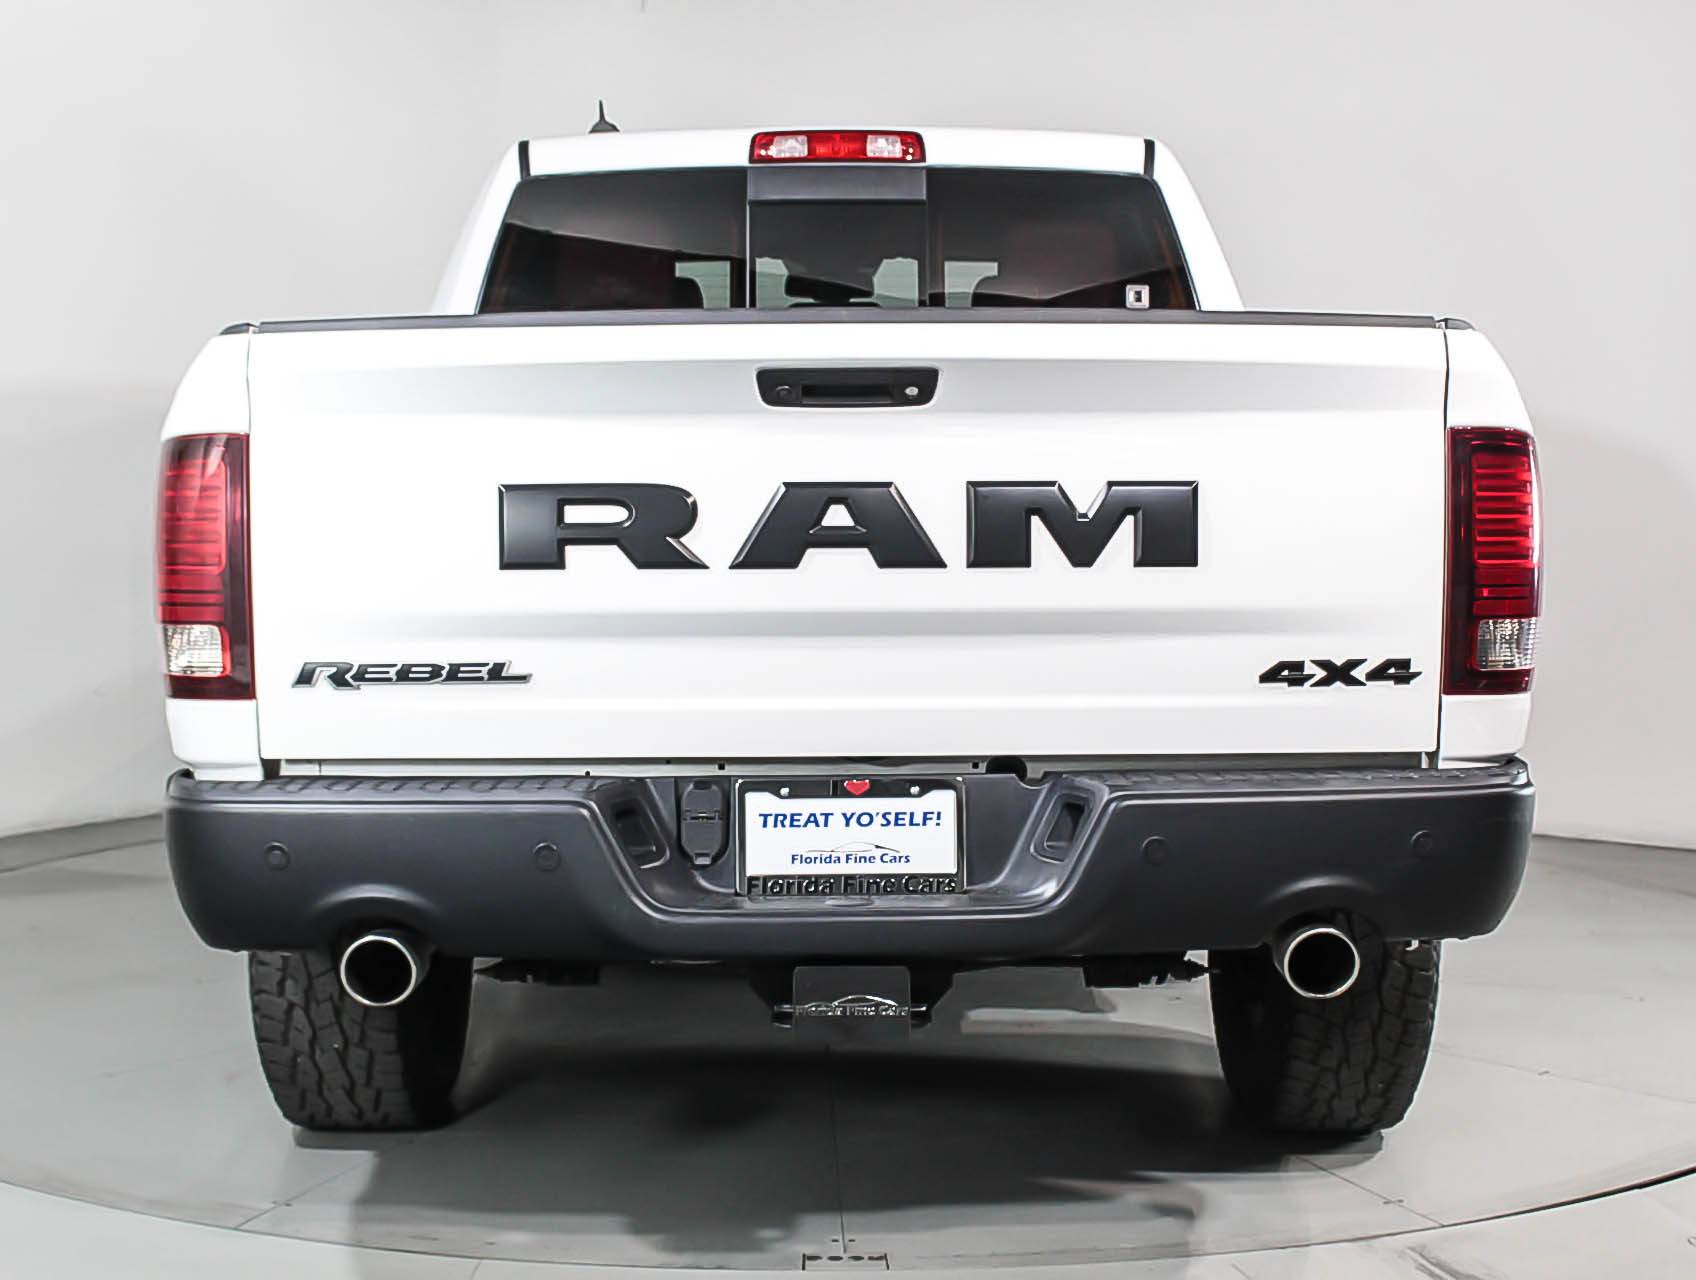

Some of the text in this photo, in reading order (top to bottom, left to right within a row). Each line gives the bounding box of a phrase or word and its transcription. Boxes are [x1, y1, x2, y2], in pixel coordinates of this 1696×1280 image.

[499, 481, 1201, 570] RAM
[292, 660, 533, 690] REBEL
[1258, 658, 1423, 688] 4X4
[758, 811, 942, 828] TREAT YO'SELF!
[791, 852, 911, 864] Florida Fine Cars
[747, 874, 957, 896] Florida Fine Cars
